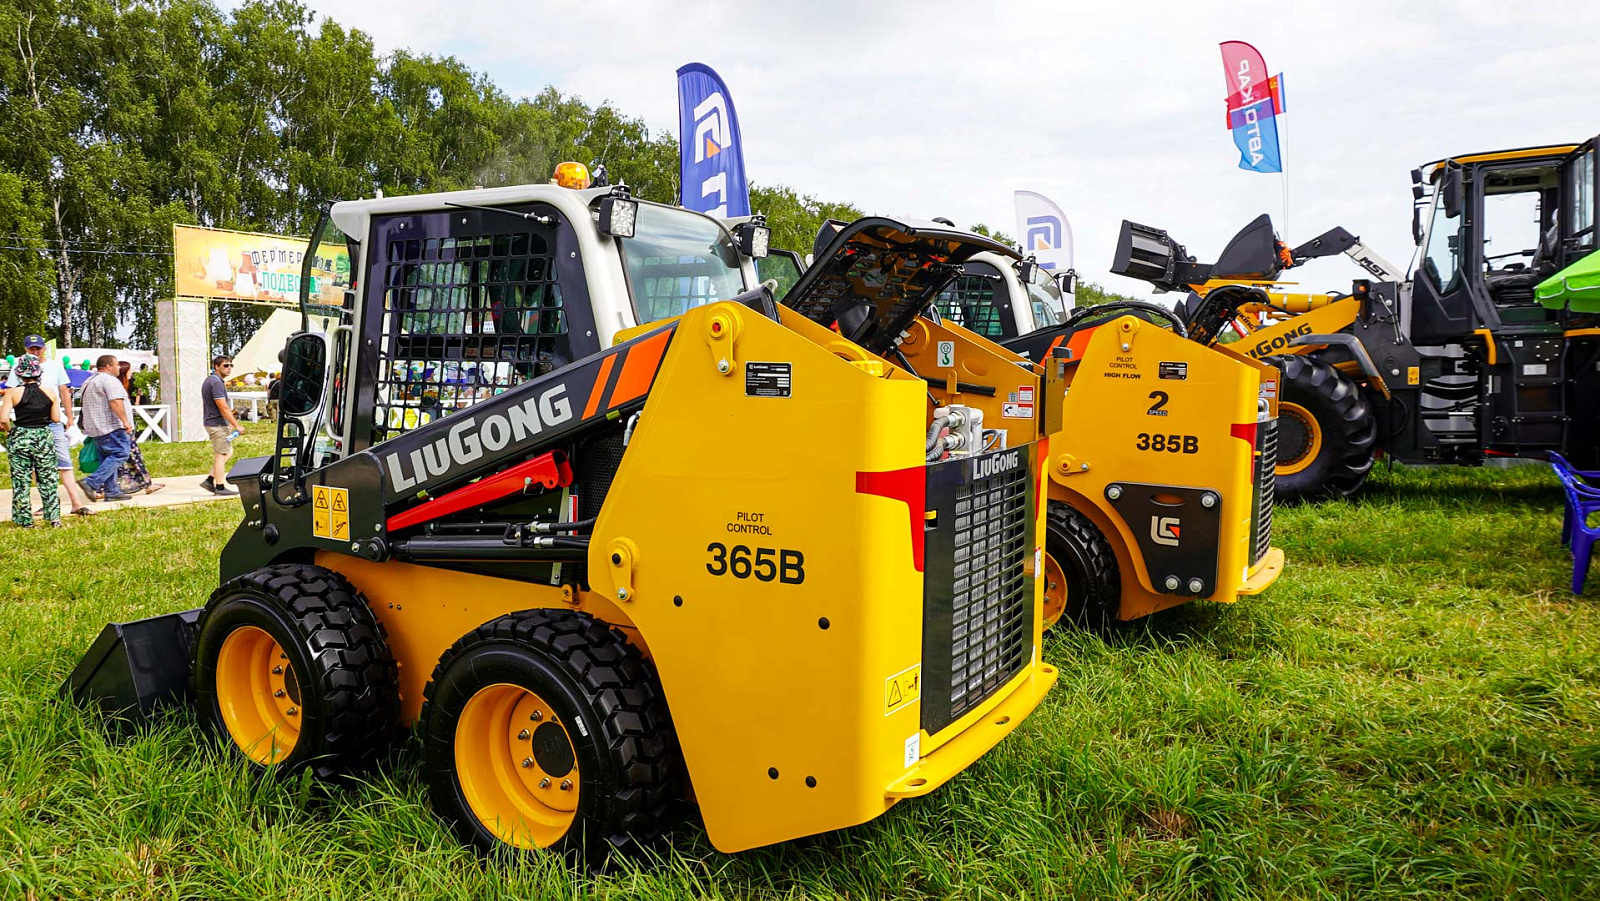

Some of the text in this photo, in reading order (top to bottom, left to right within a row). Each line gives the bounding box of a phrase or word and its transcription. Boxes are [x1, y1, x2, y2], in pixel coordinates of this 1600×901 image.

[1360, 256, 1390, 276] MST
[1109, 362, 1138, 370] CONTROL
[1147, 390, 1169, 416] 2
[1136, 433, 1199, 454] 385B
[737, 512, 764, 522] PILOT
[727, 523, 772, 535] CONTROL
[706, 542, 805, 585] 365B
